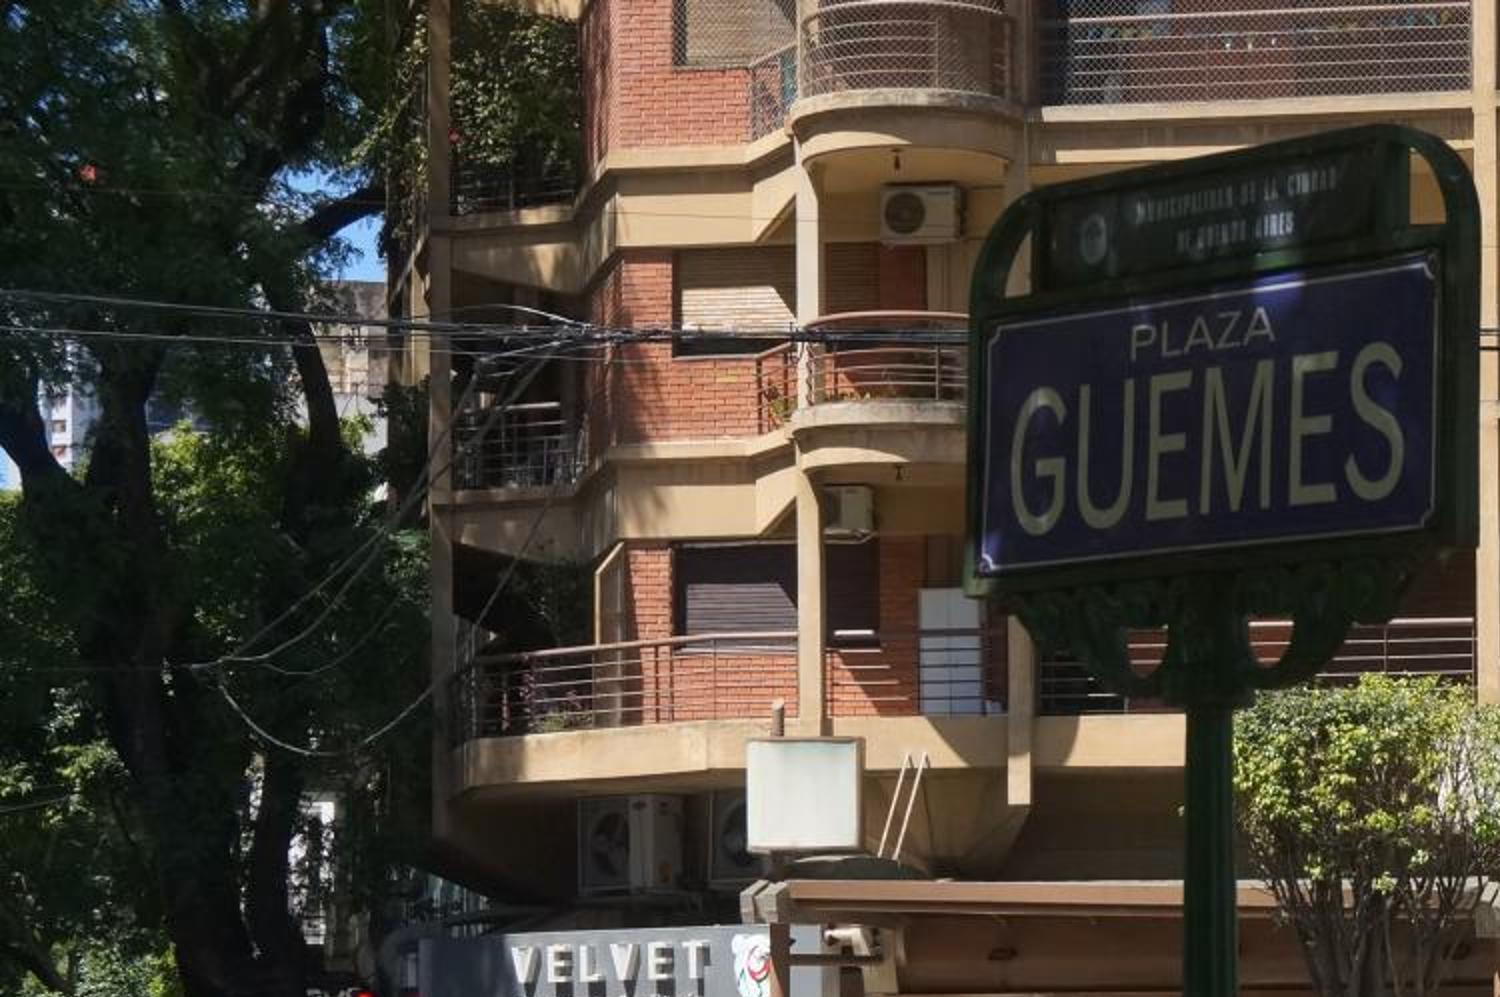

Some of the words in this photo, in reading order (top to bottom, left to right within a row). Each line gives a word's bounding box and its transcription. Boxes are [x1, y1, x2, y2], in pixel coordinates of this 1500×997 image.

[1255, 211, 1294, 239] AIRES
[1131, 307, 1275, 362] PLAZA
[1010, 341, 1405, 536] GUEMES
[511, 940, 710, 983] VELVET
